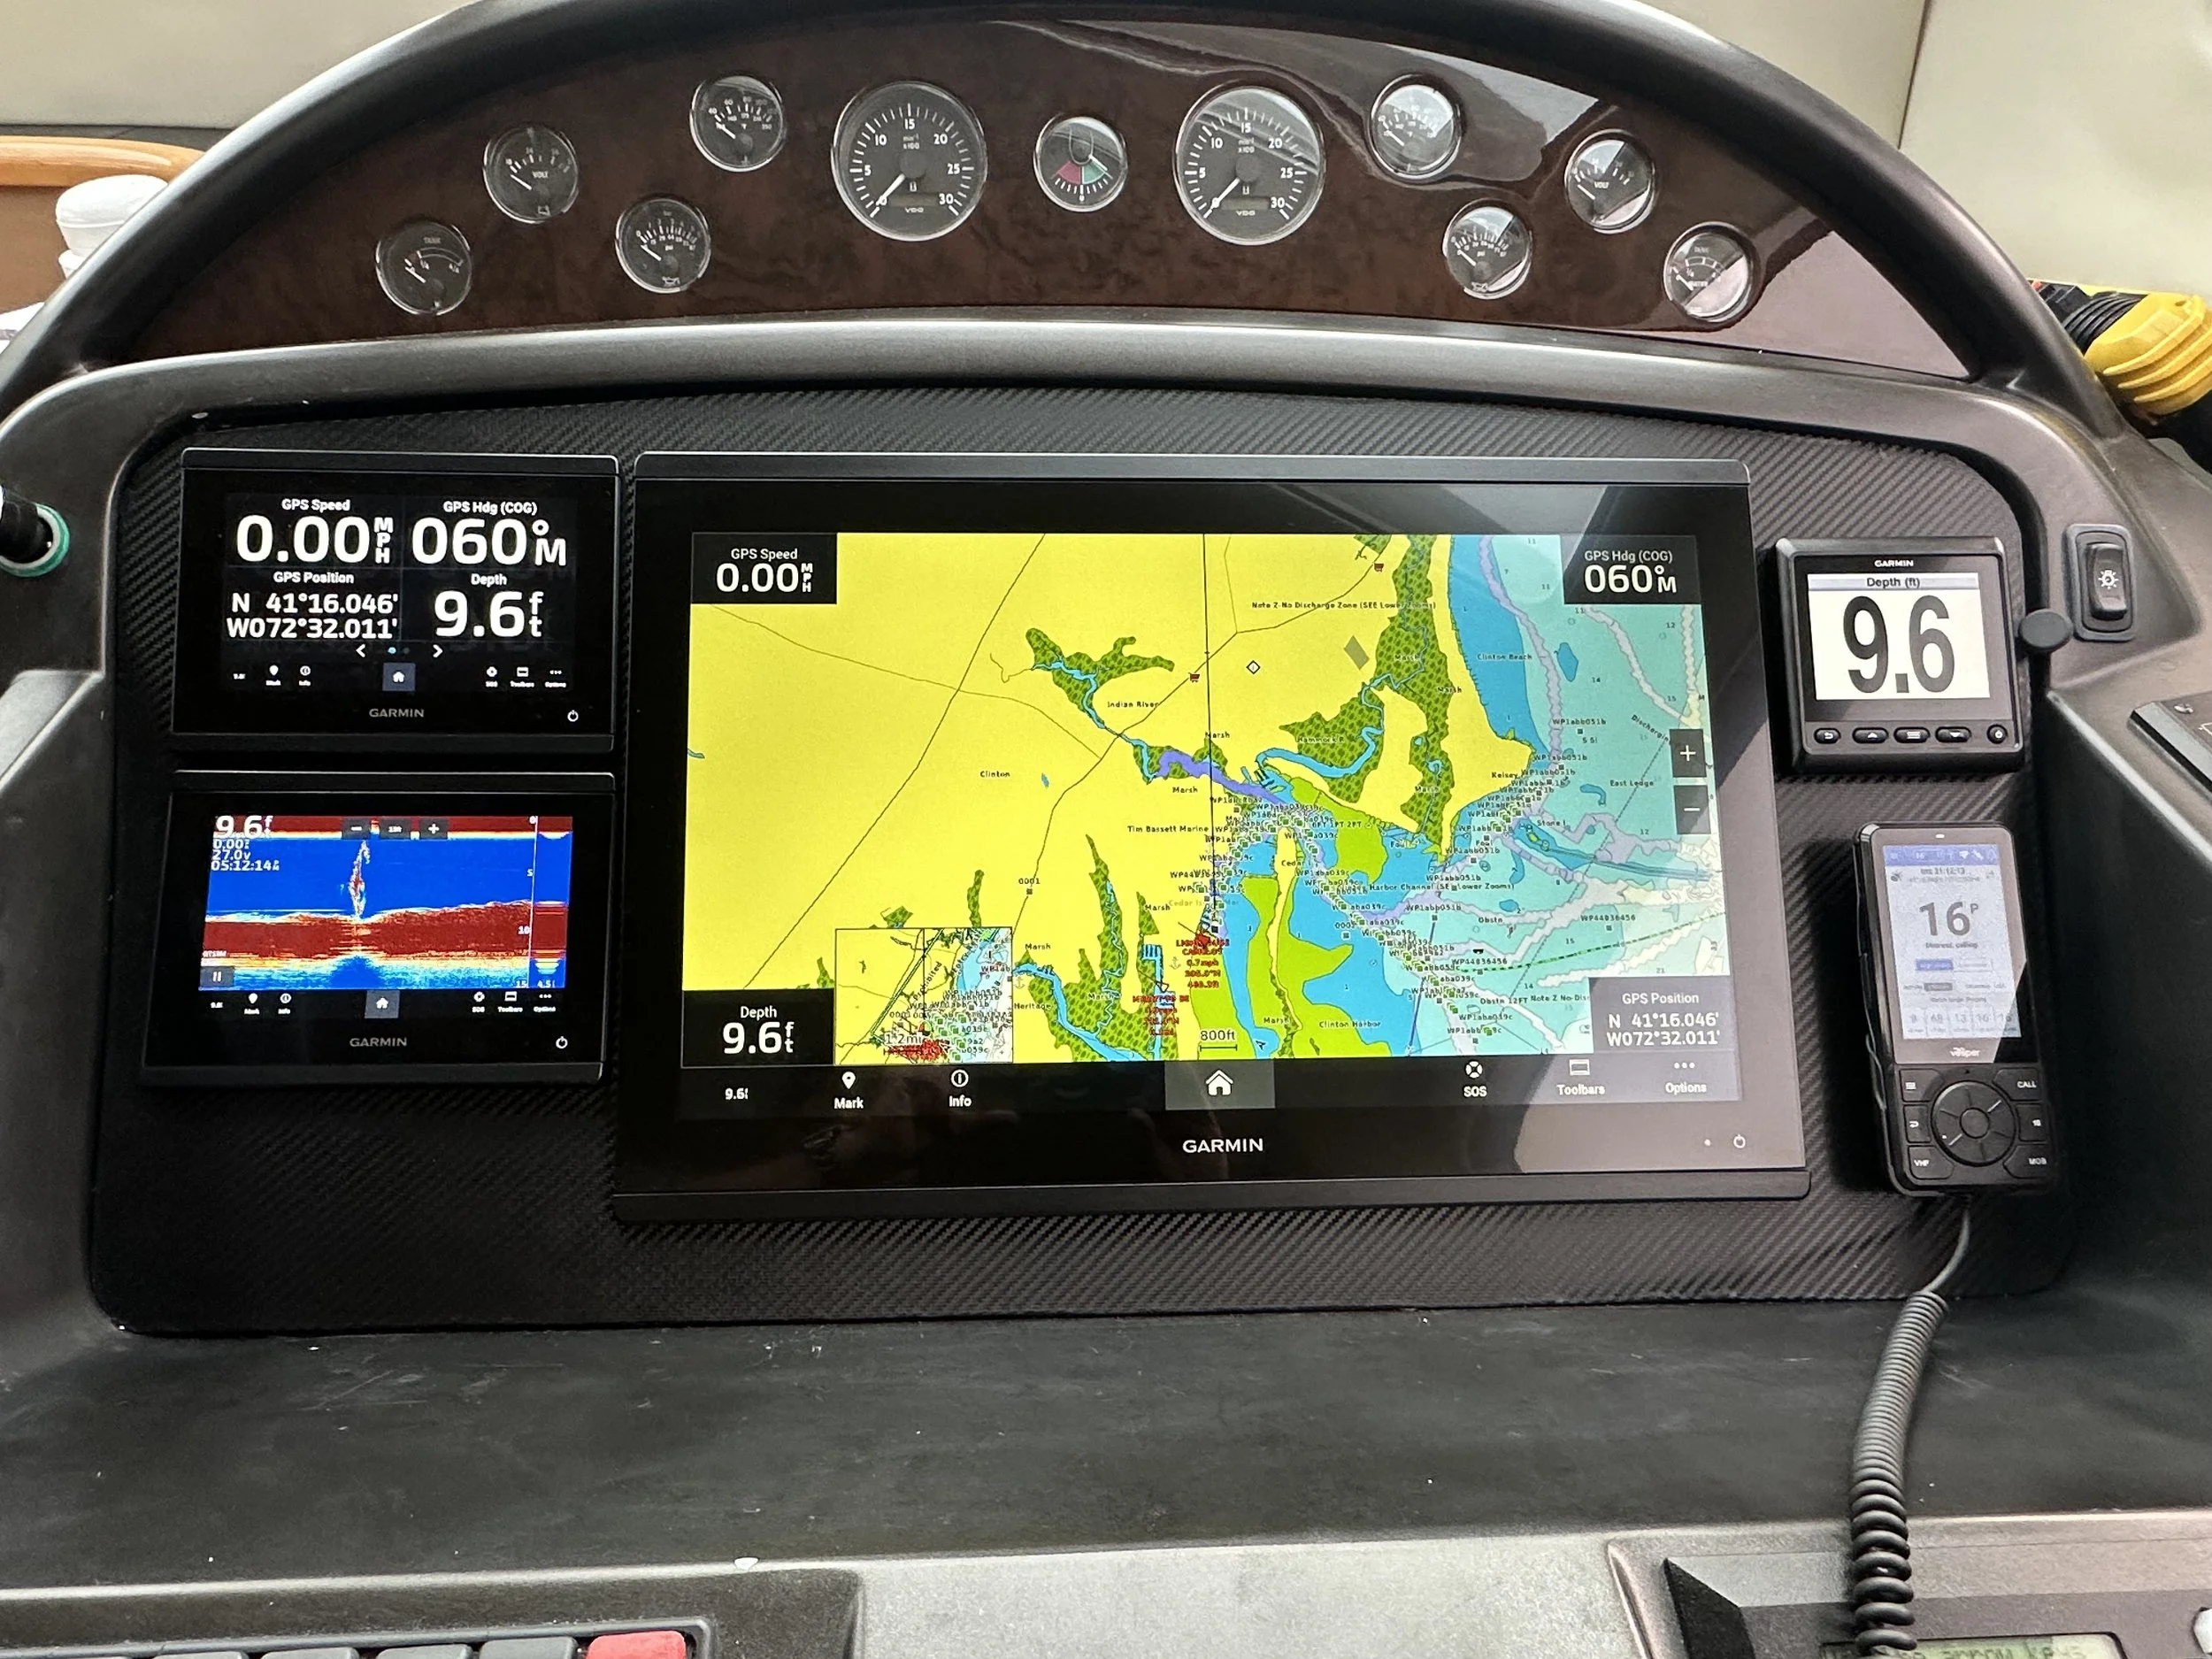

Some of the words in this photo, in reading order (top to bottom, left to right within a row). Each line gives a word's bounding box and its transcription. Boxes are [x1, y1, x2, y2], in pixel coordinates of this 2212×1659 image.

[904, 119, 916, 130] 15
[1240, 122, 1251, 134] 15
[875, 134, 887, 146] 10
[933, 134, 948, 145] 20
[1211, 137, 1223, 149] 10
[1268, 138, 1283, 149] 20
[864, 165, 872, 176] 5
[948, 164, 961, 175] 25
[1199, 167, 1206, 178] 5
[1280, 167, 1294, 178] 25
[939, 193, 954, 204] 30
[1271, 197, 1286, 209] 30
[281, 498, 310, 511] GPS
[311, 499, 350, 512] Speed
[443, 502, 470, 513] GPS
[472, 502, 497, 515] Hdg
[500, 501, 538, 516] (COG)
[235, 514, 371, 564] 0.00
[731, 549, 757, 560] GPS
[760, 548, 798, 560] Speed
[1584, 550, 1609, 561] GPS
[1612, 550, 1636, 564] Hdg
[1639, 550, 1673, 564] (COG)
[273, 572, 301, 584] GPS
[303, 572, 354, 584] Position
[471, 573, 507, 587] Depth
[716, 563, 800, 592] 0.00
[1866, 577, 1901, 588] Depth
[1904, 577, 1921, 589] (ft)
[232, 593, 250, 612] N
[266, 593, 399, 614] 41°16.046'
[434, 591, 526, 637] 9.6
[227, 618, 398, 639] W072°32.011'
[1843, 595, 1955, 694] 9.6
[369, 708, 425, 718] GARMIN
[979, 770, 1010, 779] Clinton
[211, 860, 272, 871] 05:12:14
[1919, 902, 1970, 936] 16
[1970, 902, 1979, 914] P
[518, 926, 531, 935] 10
[516, 979, 527, 988] 15
[1623, 993, 1646, 1004] GPS
[1648, 993, 1700, 1004] Position
[1014, 1002, 1051, 1010] Heritage
[741, 1007, 777, 1019] Depth
[1609, 1014, 1621, 1027] N
[1632, 1012, 1719, 1028] 41°16.046'
[722, 1021, 781, 1054] 9.6
[1201, 1029, 1235, 1041] 800ft
[1607, 1030, 1720, 1047] W072°32.011'
[349, 1037, 407, 1048] GARMIN
[1557, 1084, 1605, 1096] Toolbars
[1665, 1082, 1707, 1095] Options
[2017, 1080, 2037, 1089] CALL
[1463, 1086, 1487, 1097] SOS
[833, 1097, 864, 1110] Mark
[949, 1095, 972, 1108] Info
[1182, 1138, 1264, 1153] GARMIN
[1914, 1158, 1930, 1167] VHF
